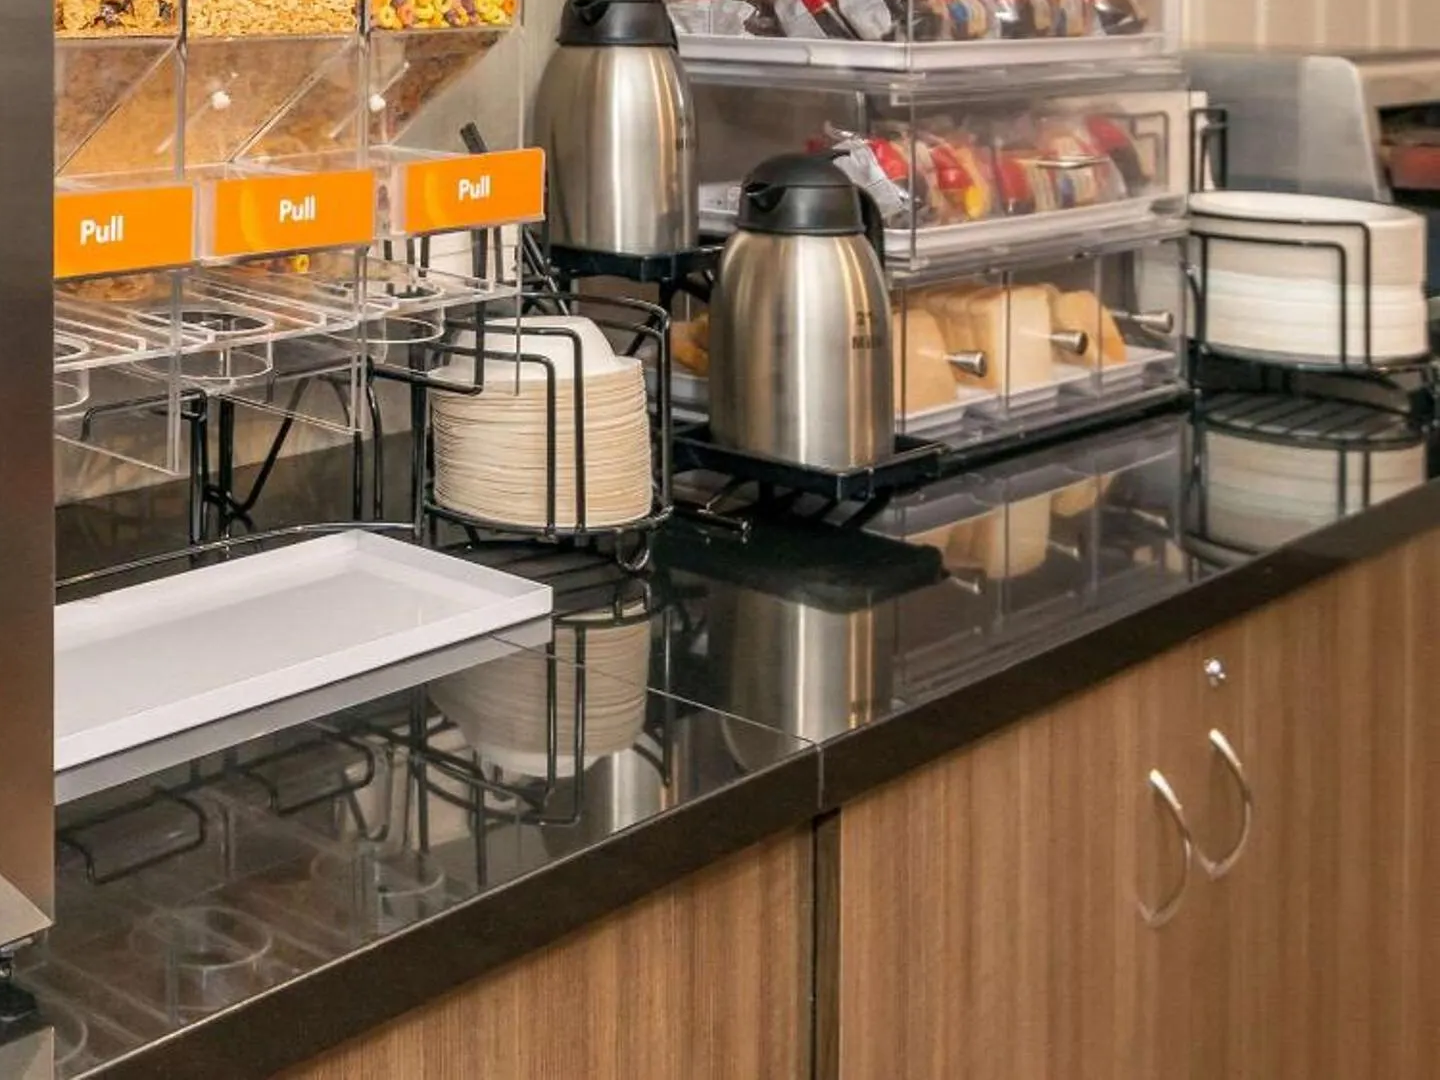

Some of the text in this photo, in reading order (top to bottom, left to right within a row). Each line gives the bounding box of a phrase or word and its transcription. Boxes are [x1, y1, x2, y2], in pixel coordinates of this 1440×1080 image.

[458, 175, 491, 200] Pull
[279, 195, 316, 223] Pull
[80, 216, 124, 245] Pull
